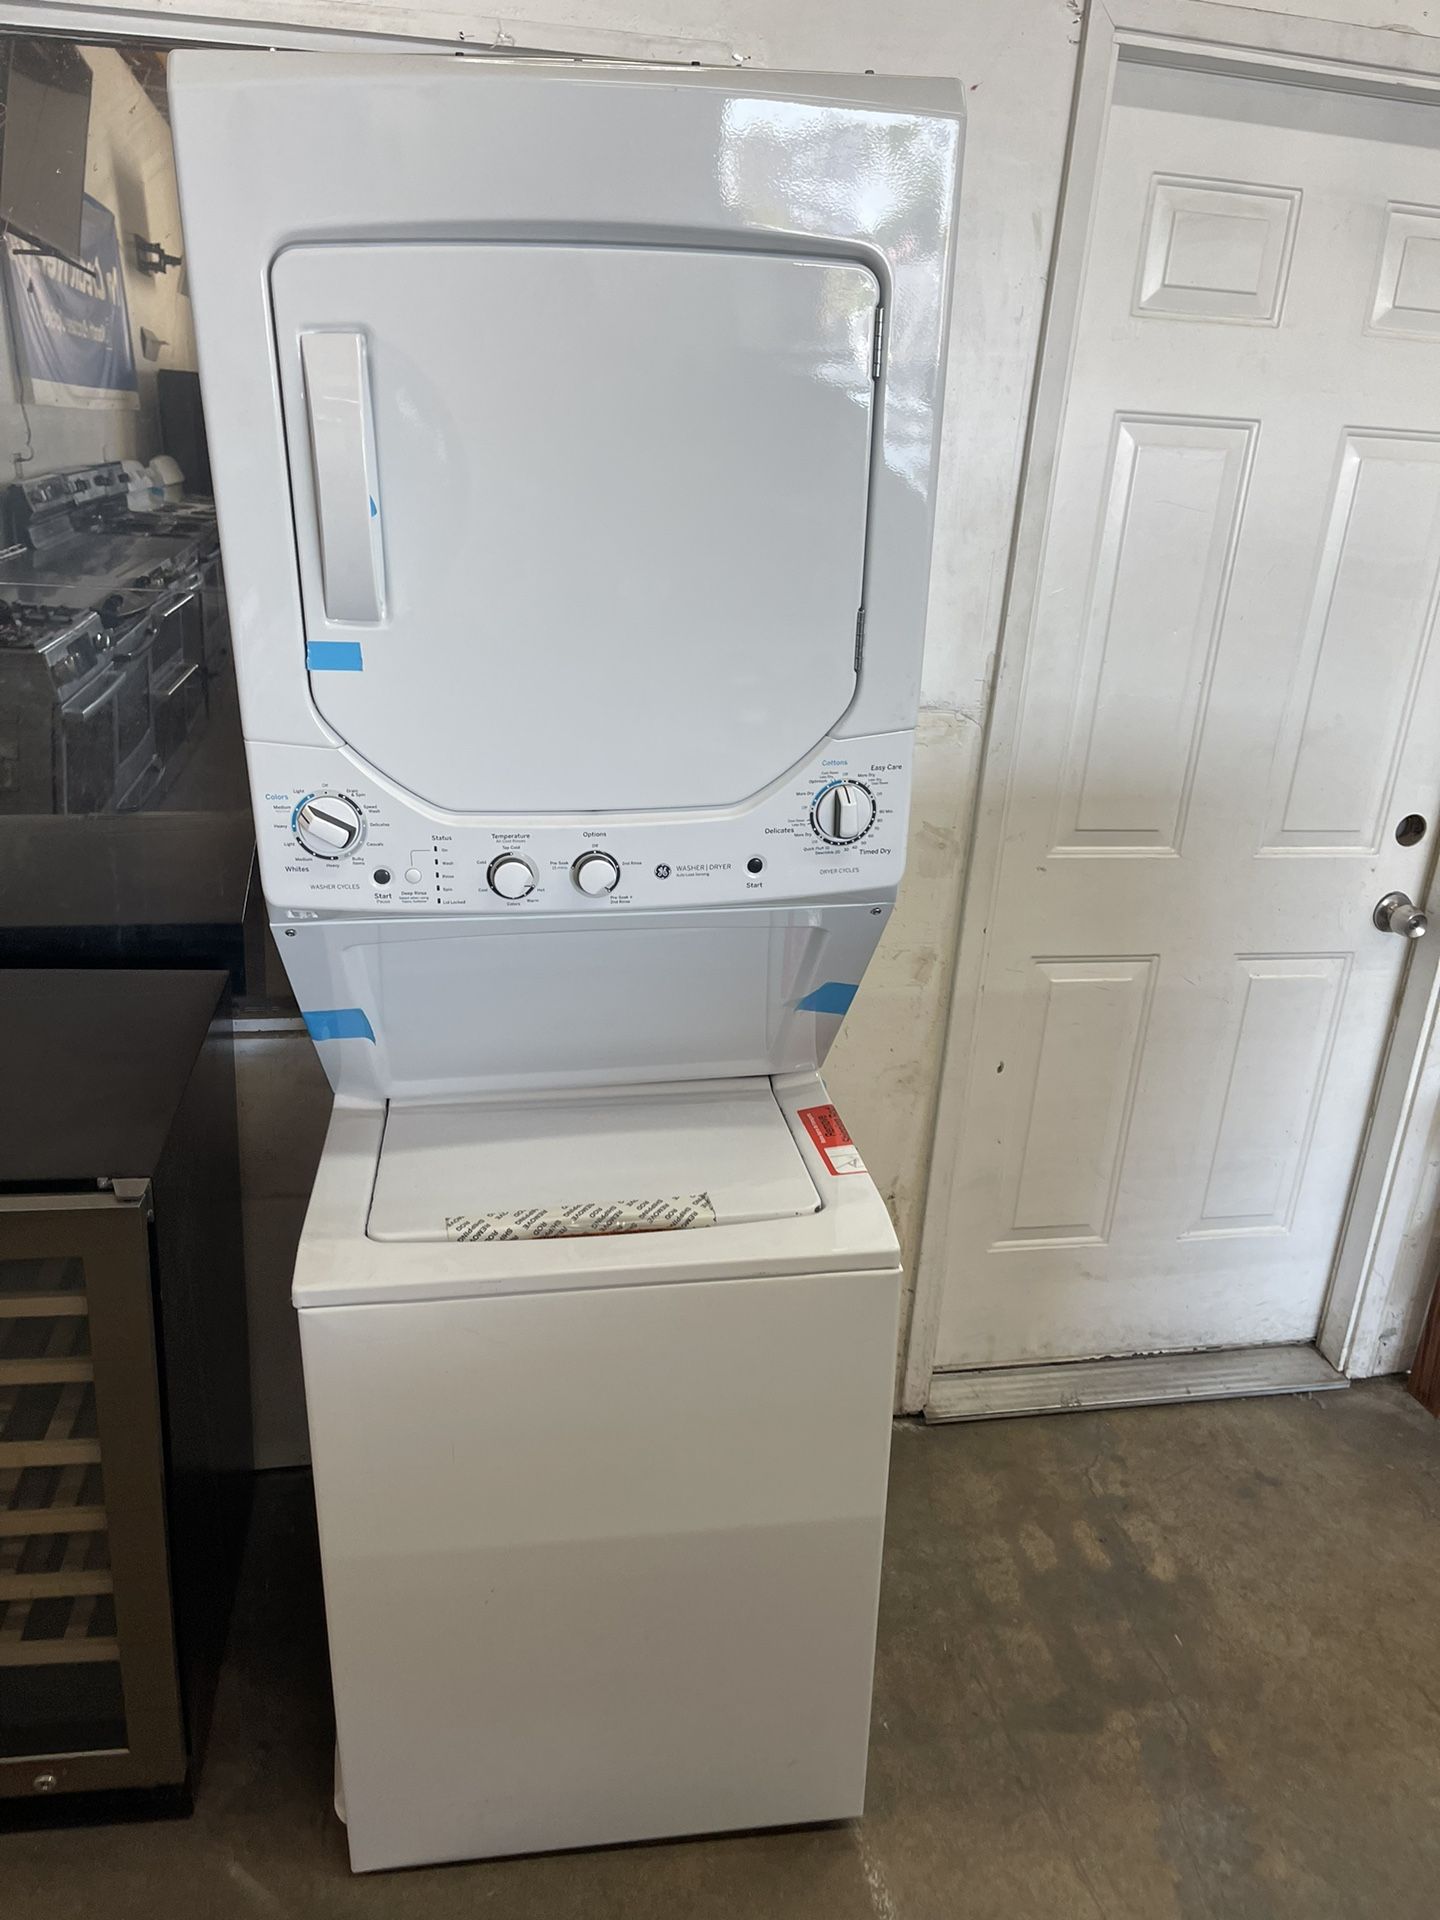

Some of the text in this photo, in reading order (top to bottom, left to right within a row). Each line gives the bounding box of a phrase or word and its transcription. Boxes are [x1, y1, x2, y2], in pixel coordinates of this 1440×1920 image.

[871, 764, 885, 772] Easy
[265, 793, 289, 801] Colors
[285, 865, 309, 873] Whites
